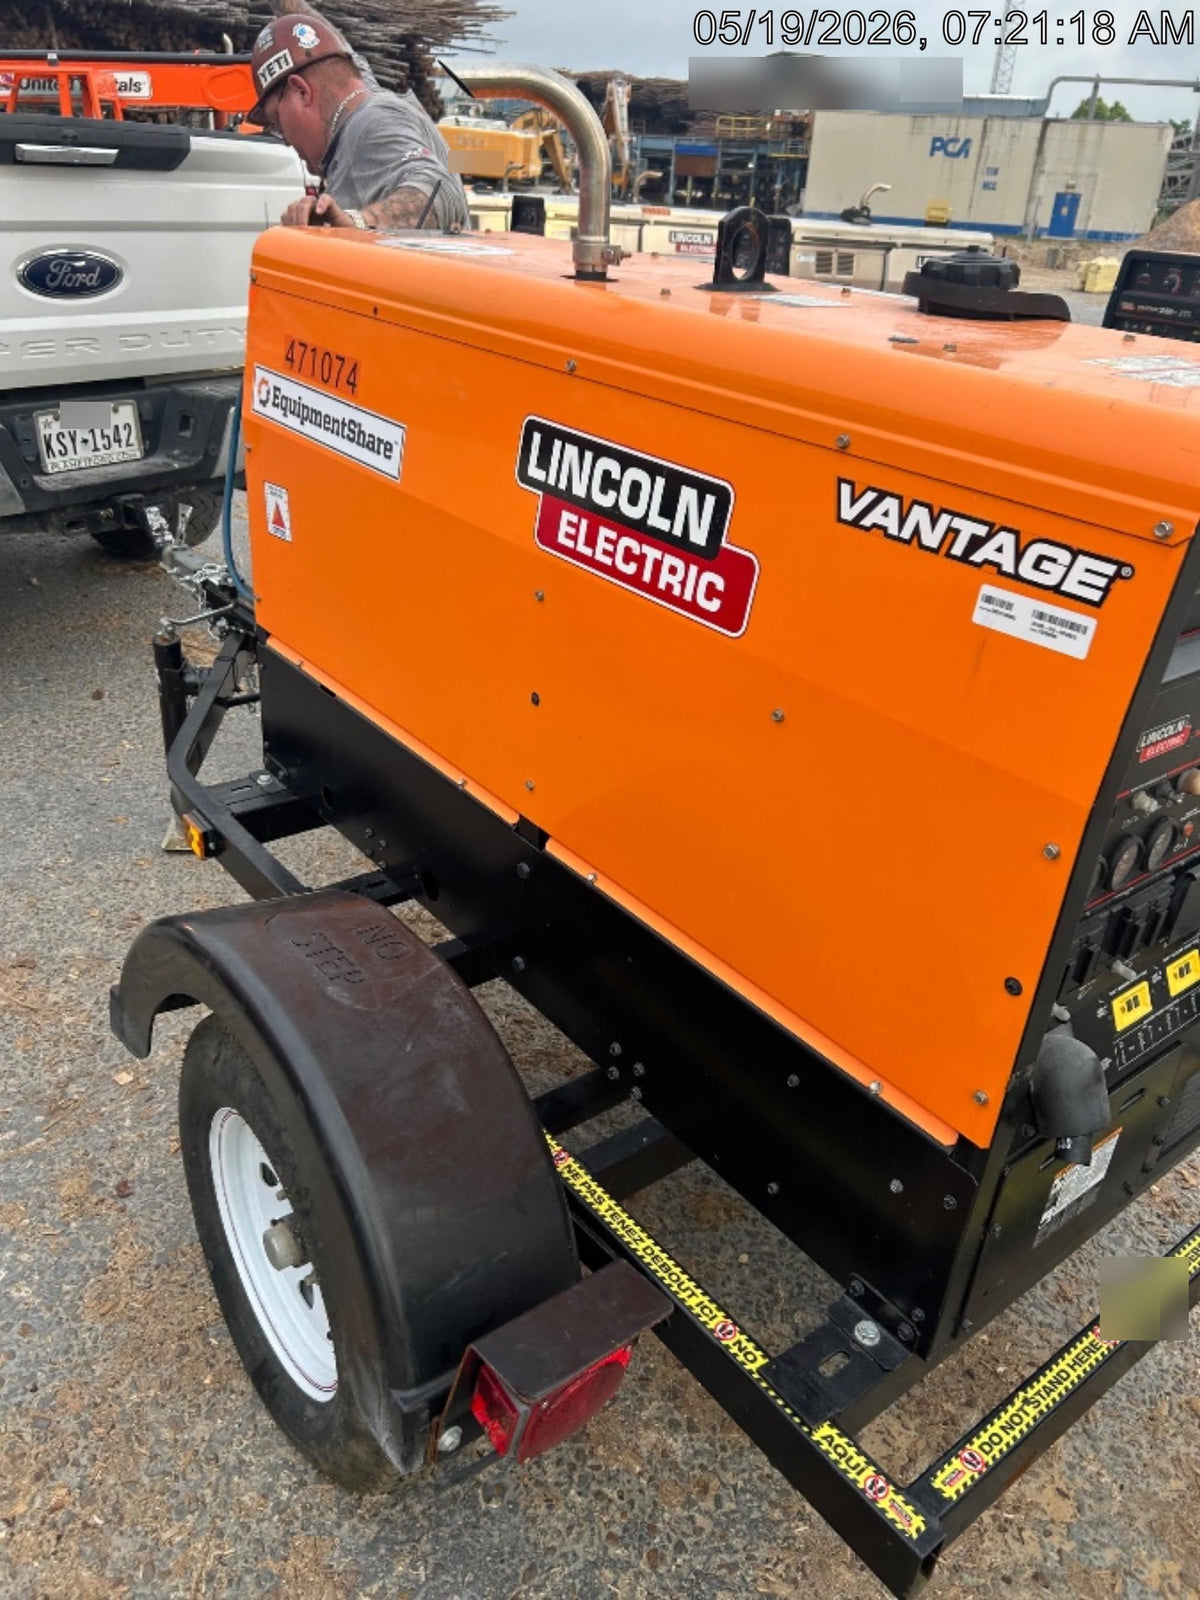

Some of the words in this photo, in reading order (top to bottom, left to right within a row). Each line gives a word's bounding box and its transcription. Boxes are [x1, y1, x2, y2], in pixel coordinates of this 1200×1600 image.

[20, 77, 60, 91] Unite
[260, 53, 290, 81] YETI
[929, 136, 973, 159] PCA
[671, 231, 713, 245] LINCOLN
[46, 259, 102, 288] Ford
[285, 339, 359, 394] 471074
[271, 386, 394, 460] EquipmentShare
[527, 431, 716, 547] LINCOLN
[557, 510, 725, 613] ELECTRIC
[291, 931, 366, 984] STEP
[355, 924, 412, 960] NO
[564, 1164, 583, 1181] NE
[580, 1182, 605, 1205] PAS
[604, 1205, 646, 1246] TENEZ
[642, 1245, 700, 1299] DEBOUT
[695, 1300, 719, 1321] ICI
[733, 1340, 758, 1364] NO
[978, 1432, 1004, 1456] DO
[1000, 1403, 1031, 1436] NOT
[1027, 1368, 1071, 1410] STAND
[1066, 1338, 1101, 1373] HERE
